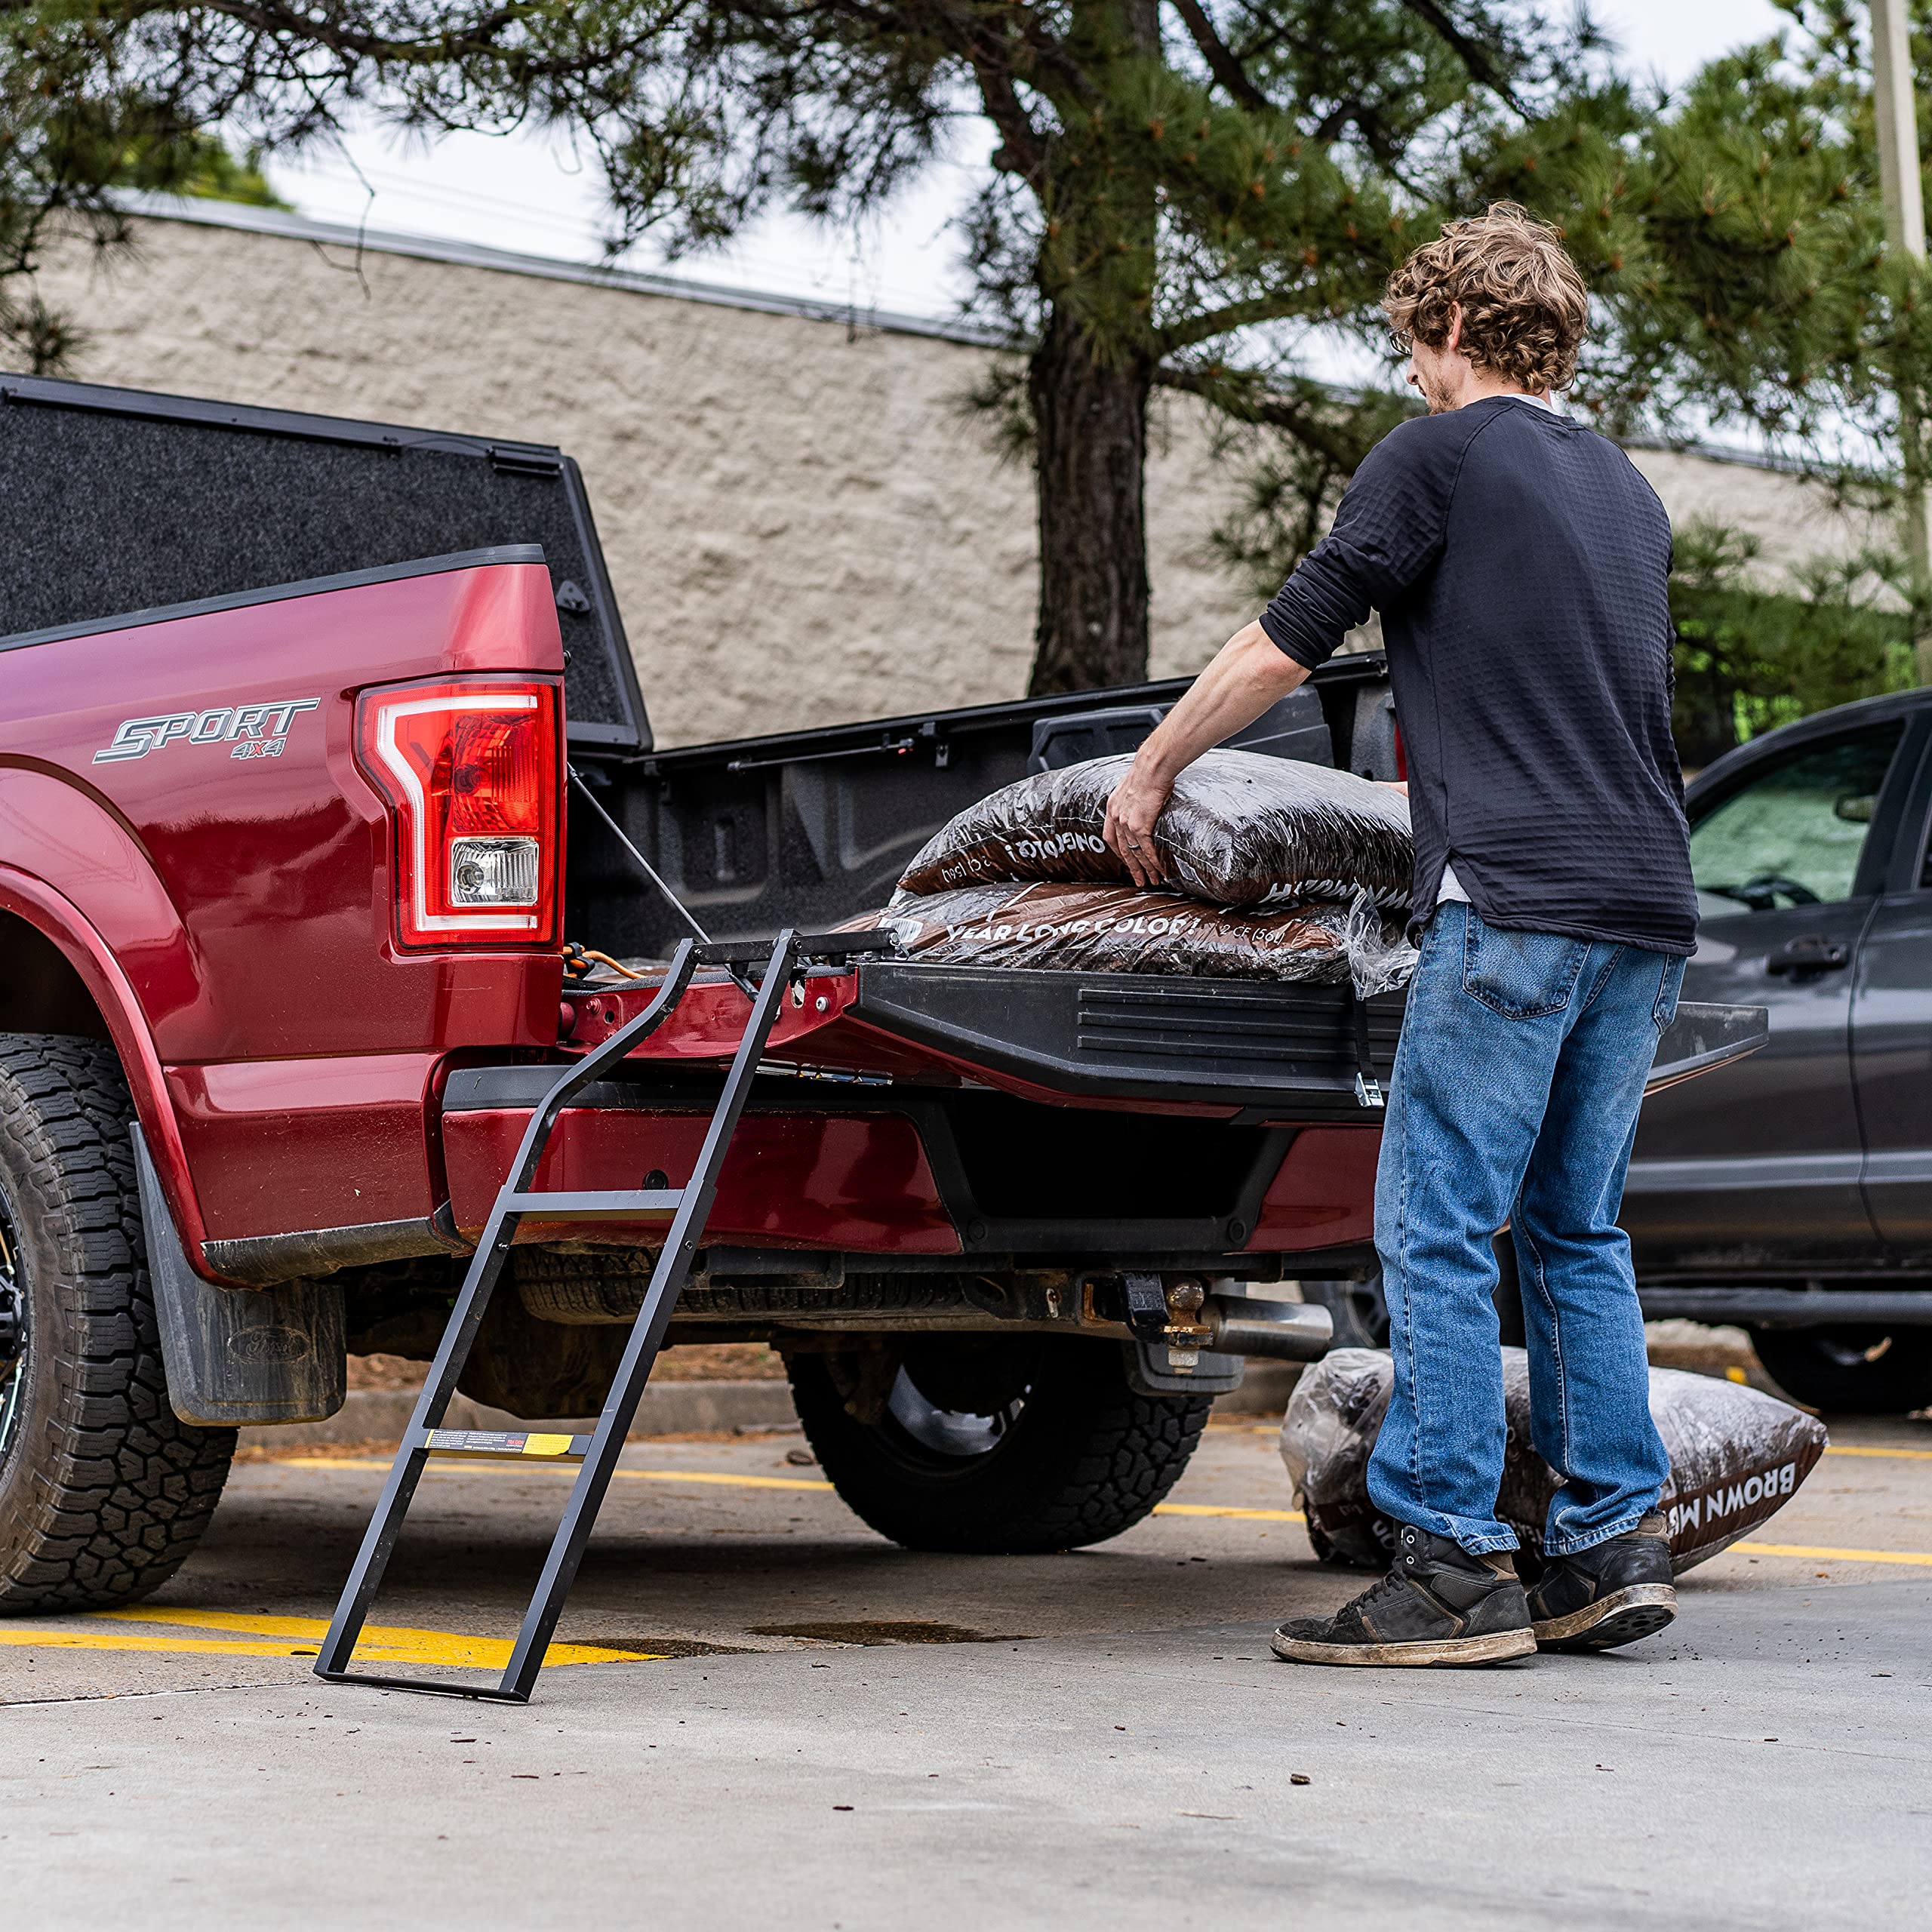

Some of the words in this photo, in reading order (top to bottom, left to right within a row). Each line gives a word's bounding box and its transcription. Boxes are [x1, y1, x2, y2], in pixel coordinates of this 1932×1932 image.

[92, 697, 321, 764] SPORT
[946, 924, 1013, 943] YEAR
[1017, 919, 1091, 943] LONG
[1094, 916, 1201, 937] COLOR!
[1220, 924, 1229, 936] 2
[1232, 925, 1251, 938] CF
[1251, 928, 1286, 946] (56L)
[1706, 1462, 1796, 1523] BROWN
